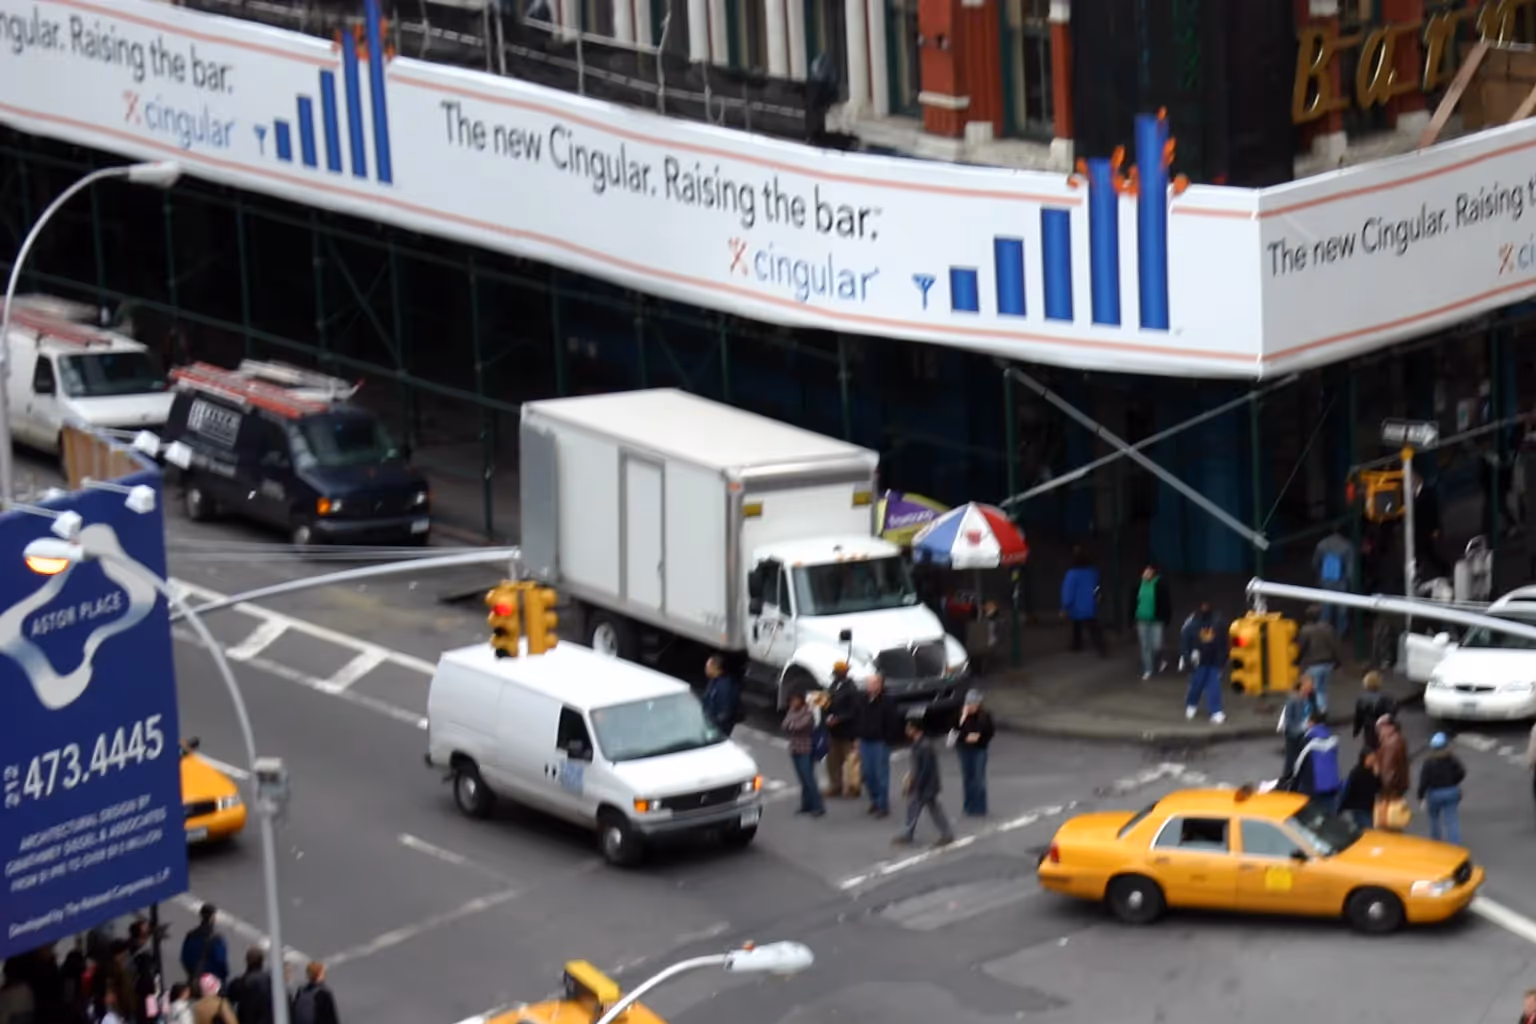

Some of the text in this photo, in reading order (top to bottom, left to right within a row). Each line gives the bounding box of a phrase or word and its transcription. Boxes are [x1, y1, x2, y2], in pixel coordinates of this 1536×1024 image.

[69, 14, 147, 83] Raising
[149, 35, 187, 84] the
[190, 42, 234, 95] bar.
[144, 93, 236, 150] cingular
[439, 100, 880, 241] The new Cingular. Raising the bar.
[1267, 236, 1308, 278] The
[1312, 231, 1357, 265] new
[1361, 201, 1451, 258] Cingular.
[1455, 180, 1525, 230] Raising
[753, 241, 881, 303] cingular
[31, 589, 123, 639] ASTOR PLACE
[22, 712, 165, 801] 473.4445
